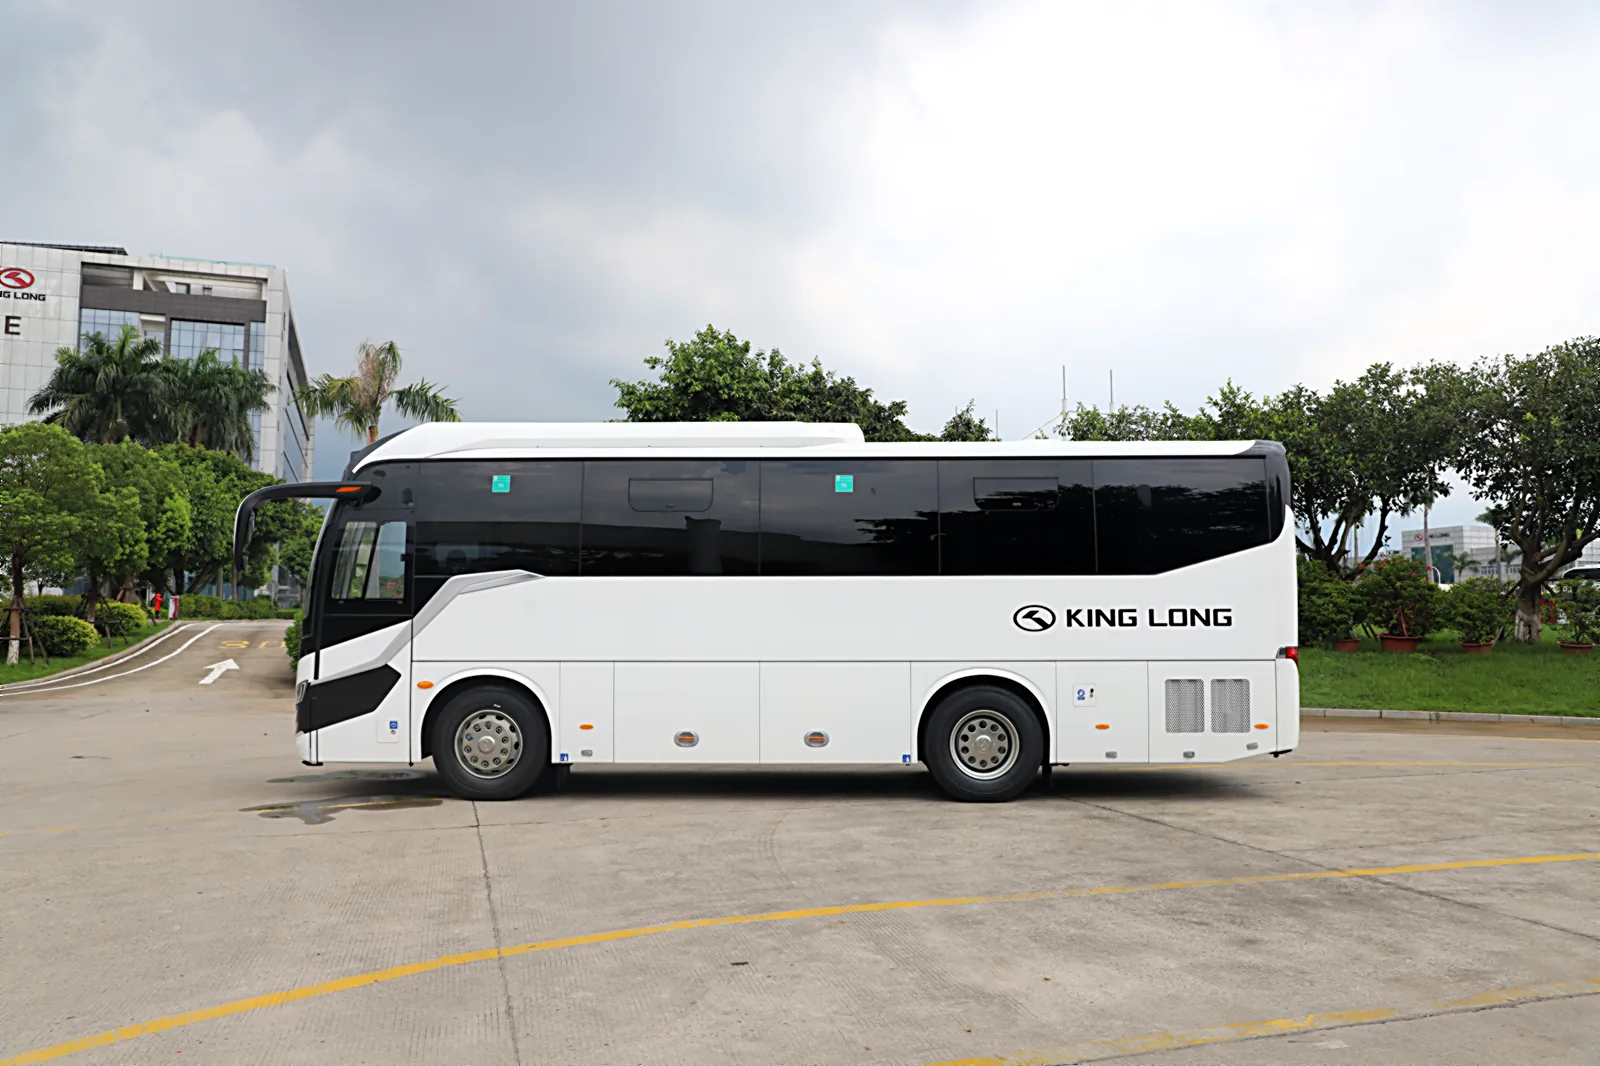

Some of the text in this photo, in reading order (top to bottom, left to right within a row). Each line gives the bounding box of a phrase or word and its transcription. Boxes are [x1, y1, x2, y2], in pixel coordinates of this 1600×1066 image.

[13, 291, 46, 301] LONG
[5, 315, 21, 335] E
[1066, 608, 1233, 627] KING LONG
